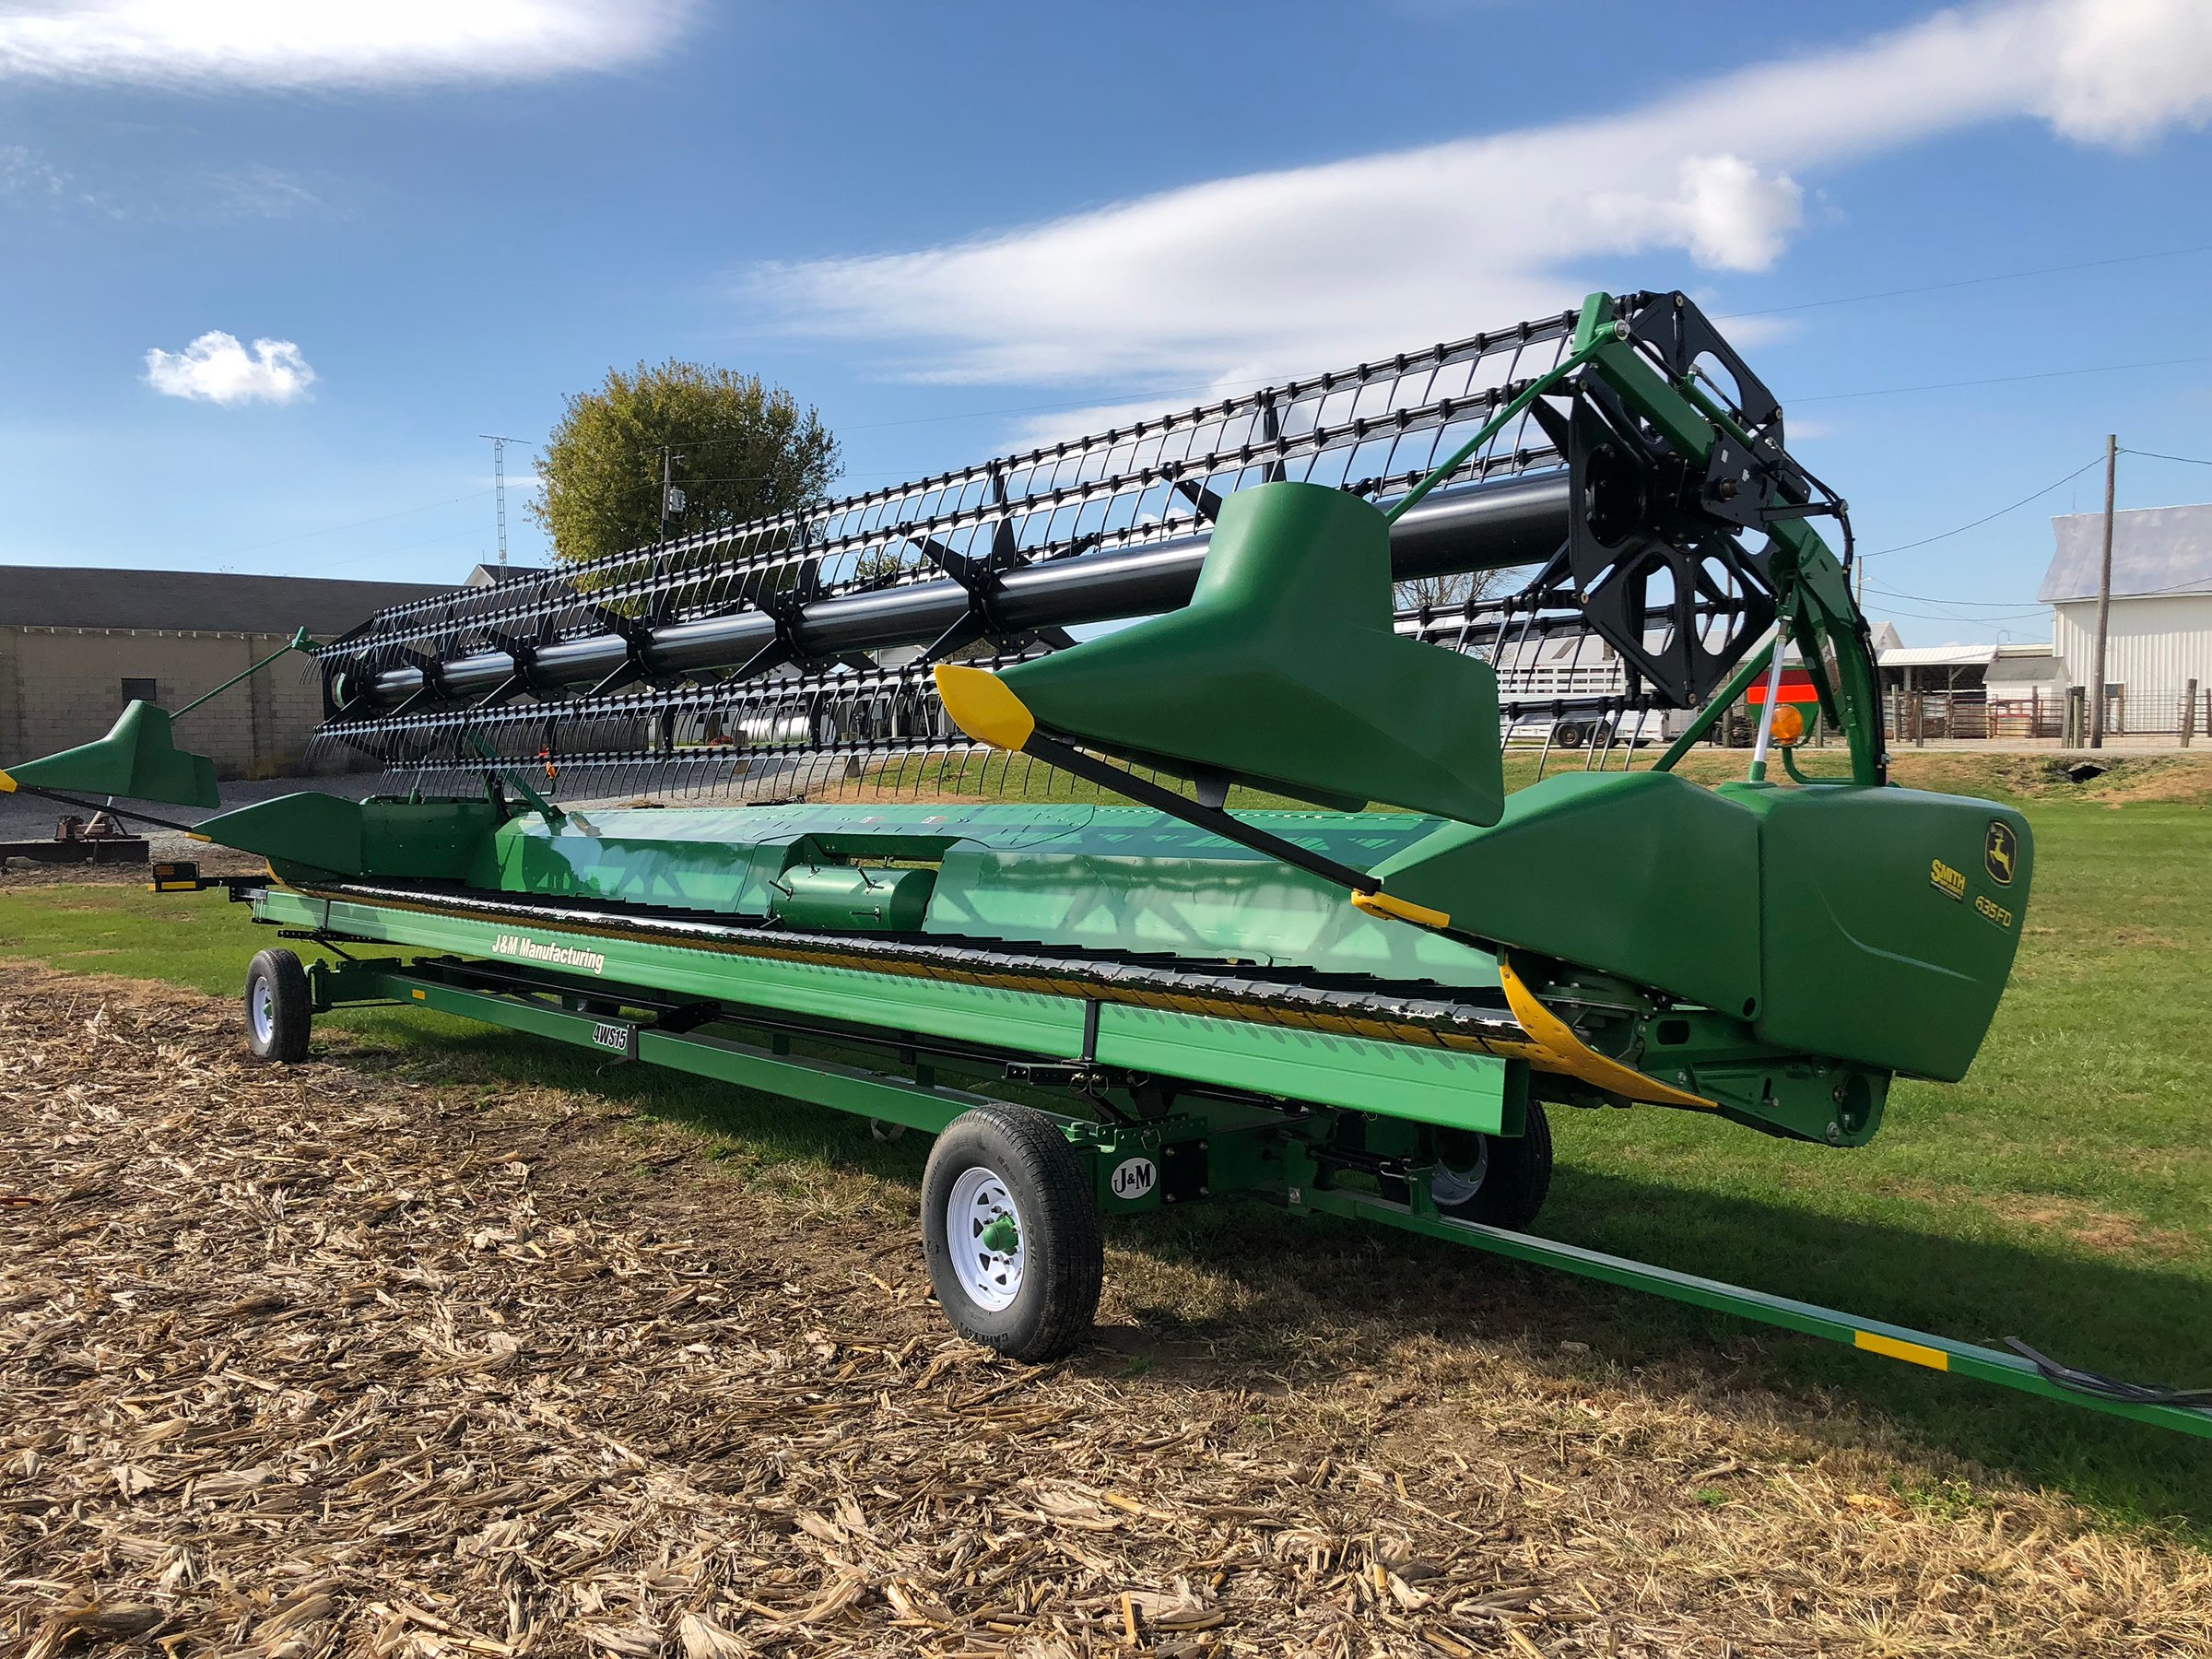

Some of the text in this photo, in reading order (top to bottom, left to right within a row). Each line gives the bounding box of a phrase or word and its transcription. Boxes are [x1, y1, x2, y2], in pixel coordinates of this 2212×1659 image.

[1931, 859, 1966, 890] SMITH
[1975, 895, 2012, 927] 635FD
[492, 935, 605, 975] J&M Manufacturing
[593, 1024, 628, 1050] 4WS15
[1113, 1163, 1151, 1193] J&M
